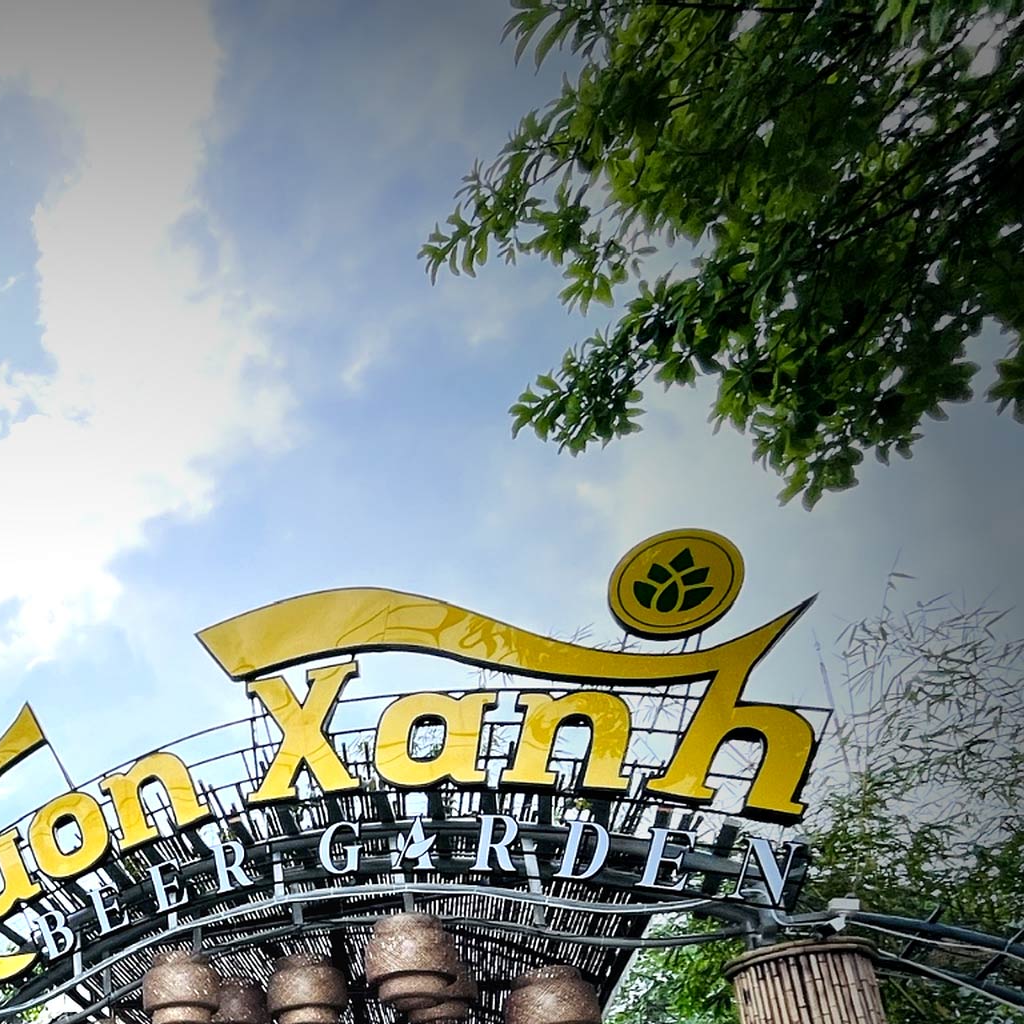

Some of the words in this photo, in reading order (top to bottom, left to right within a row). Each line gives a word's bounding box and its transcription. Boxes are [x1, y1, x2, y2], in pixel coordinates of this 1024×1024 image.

[196, 587, 832, 826] Xanh
[35, 841, 254, 961] BEER
[319, 814, 804, 909] GARDEN
